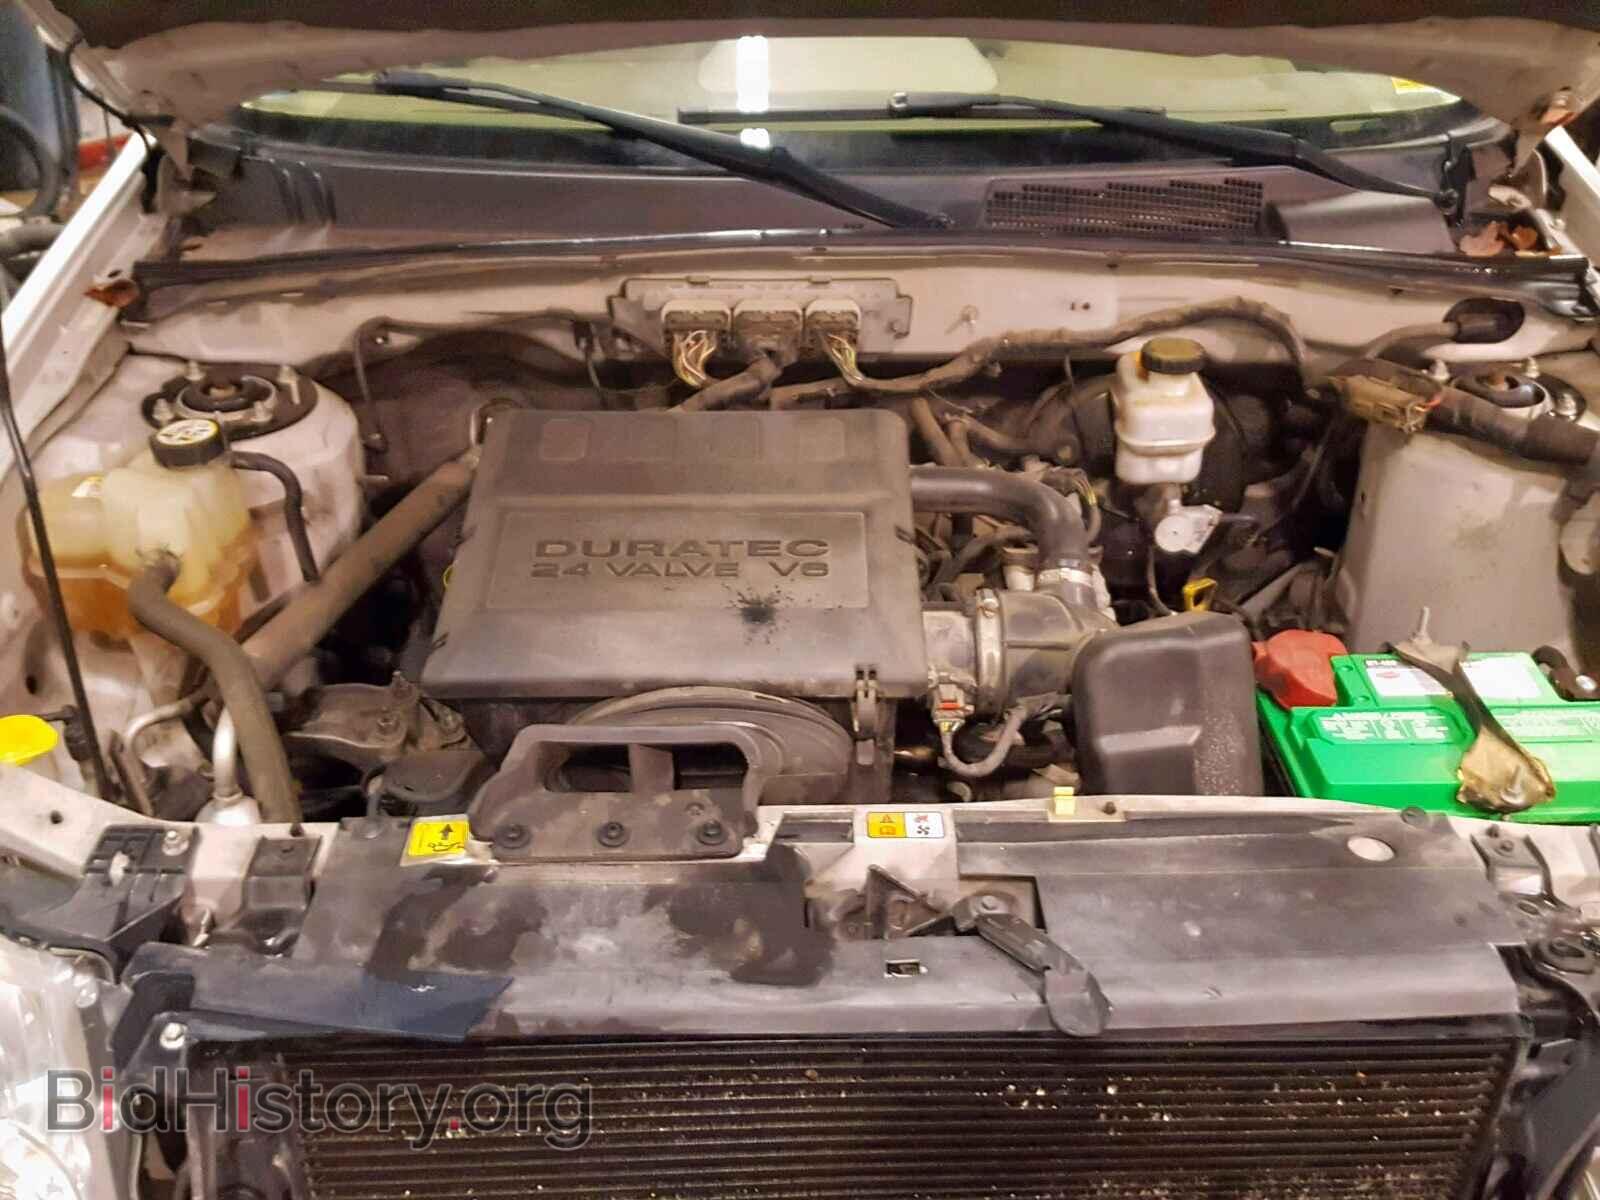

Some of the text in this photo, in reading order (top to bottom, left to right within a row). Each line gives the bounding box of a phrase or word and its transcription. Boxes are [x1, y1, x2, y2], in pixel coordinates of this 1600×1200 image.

[536, 540, 829, 558] DURATEC
[531, 562, 829, 578] 24 VALVE V6
